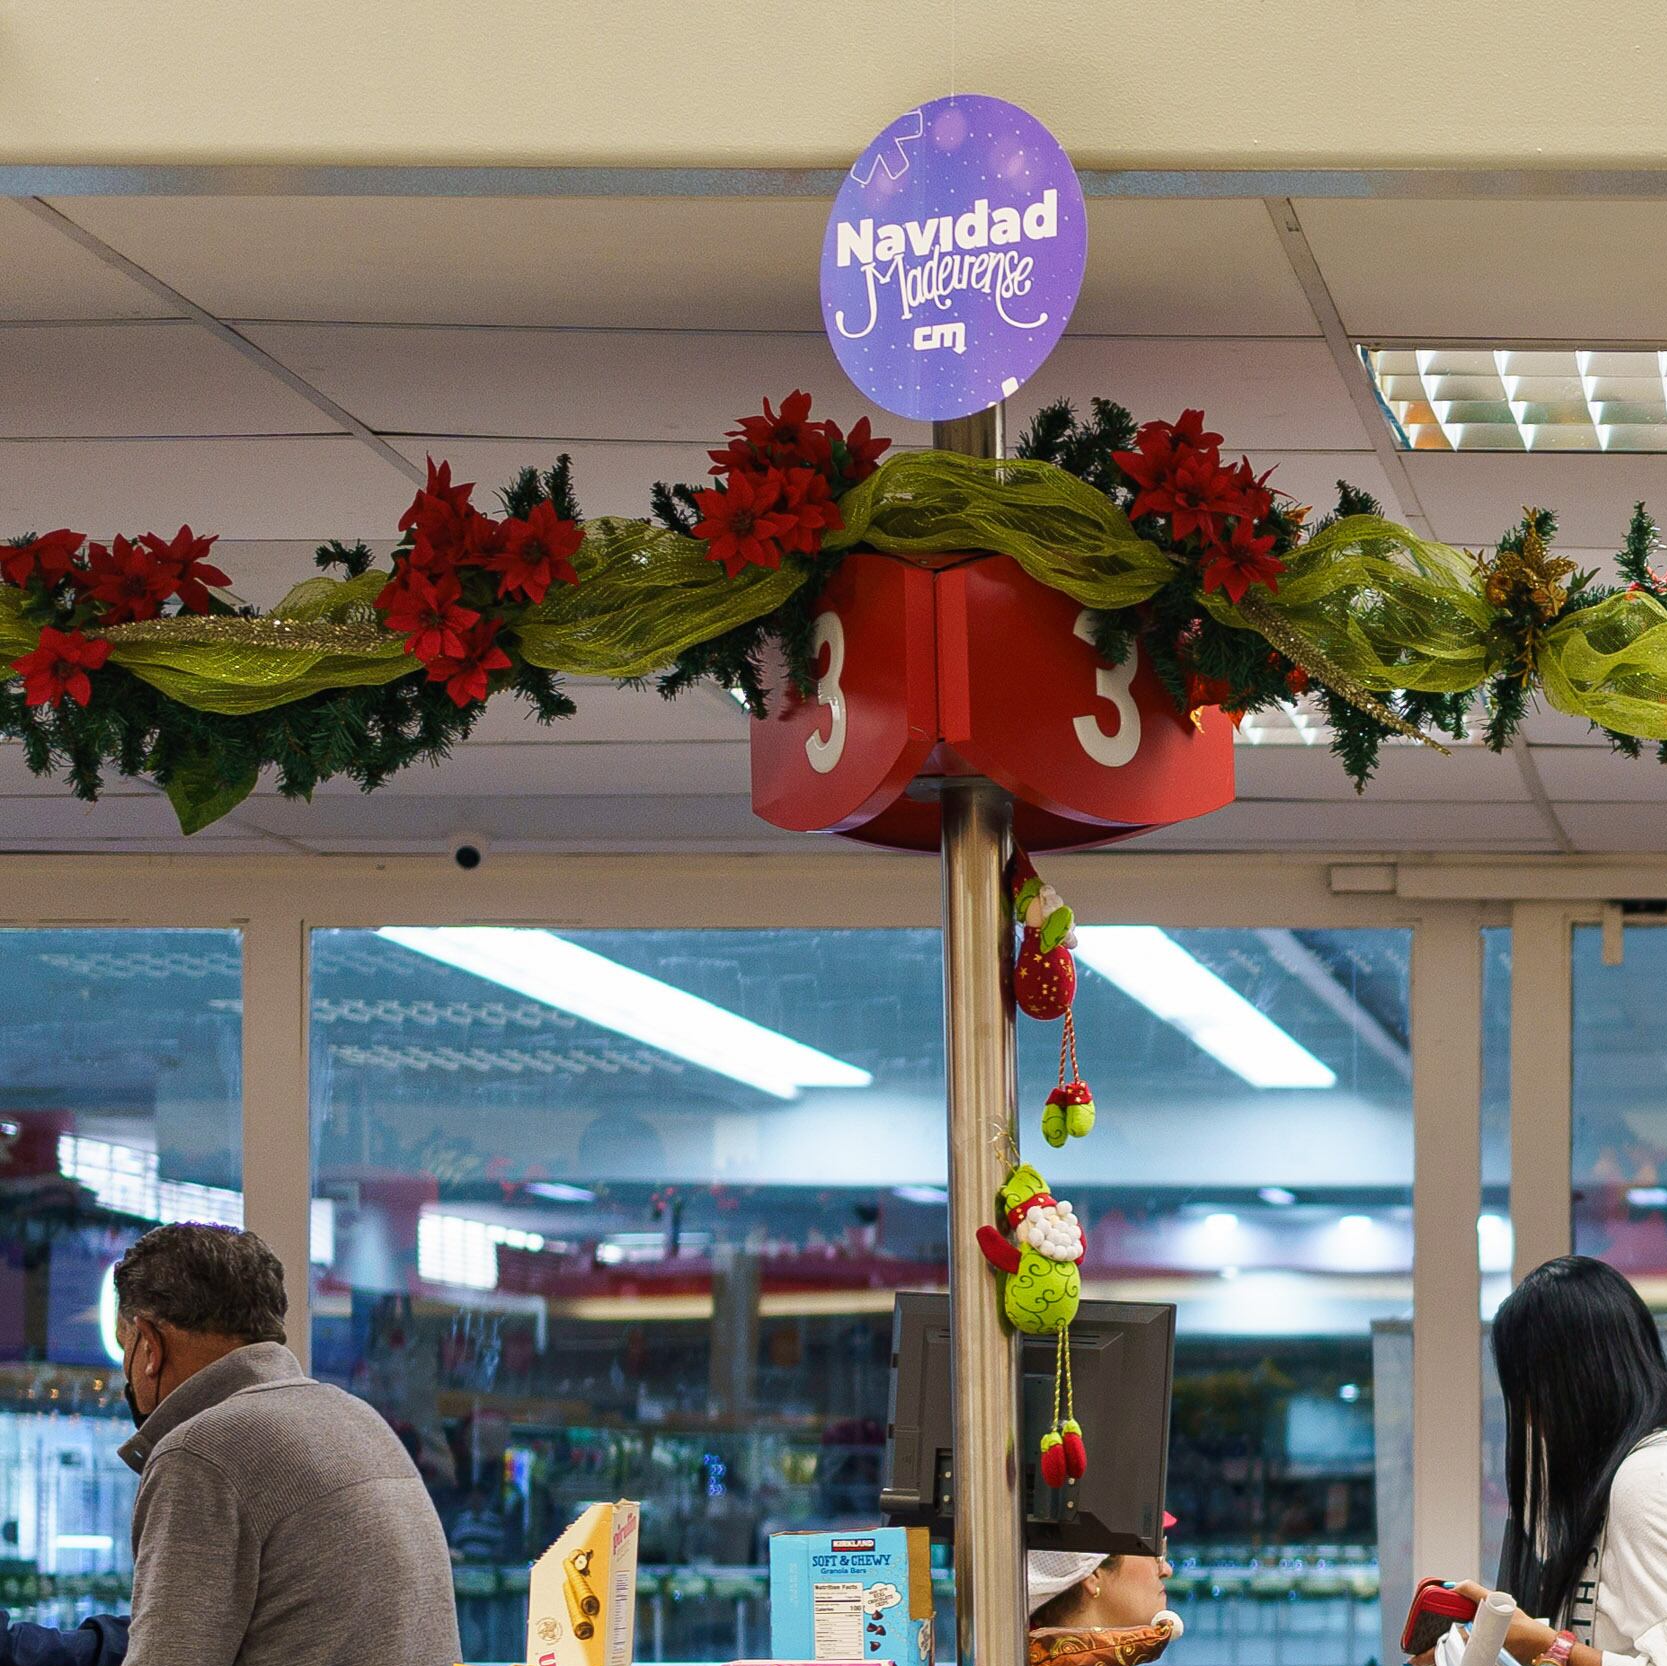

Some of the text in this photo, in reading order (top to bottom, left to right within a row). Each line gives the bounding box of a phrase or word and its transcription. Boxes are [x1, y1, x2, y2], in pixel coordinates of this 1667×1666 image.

[837, 188, 1058, 267] Navidad
[805, 610, 847, 774] 3
[1072, 608, 1142, 768] 3
[812, 1554, 892, 1567] SOFT & CHEWY
[820, 1567, 849, 1575] Granola
